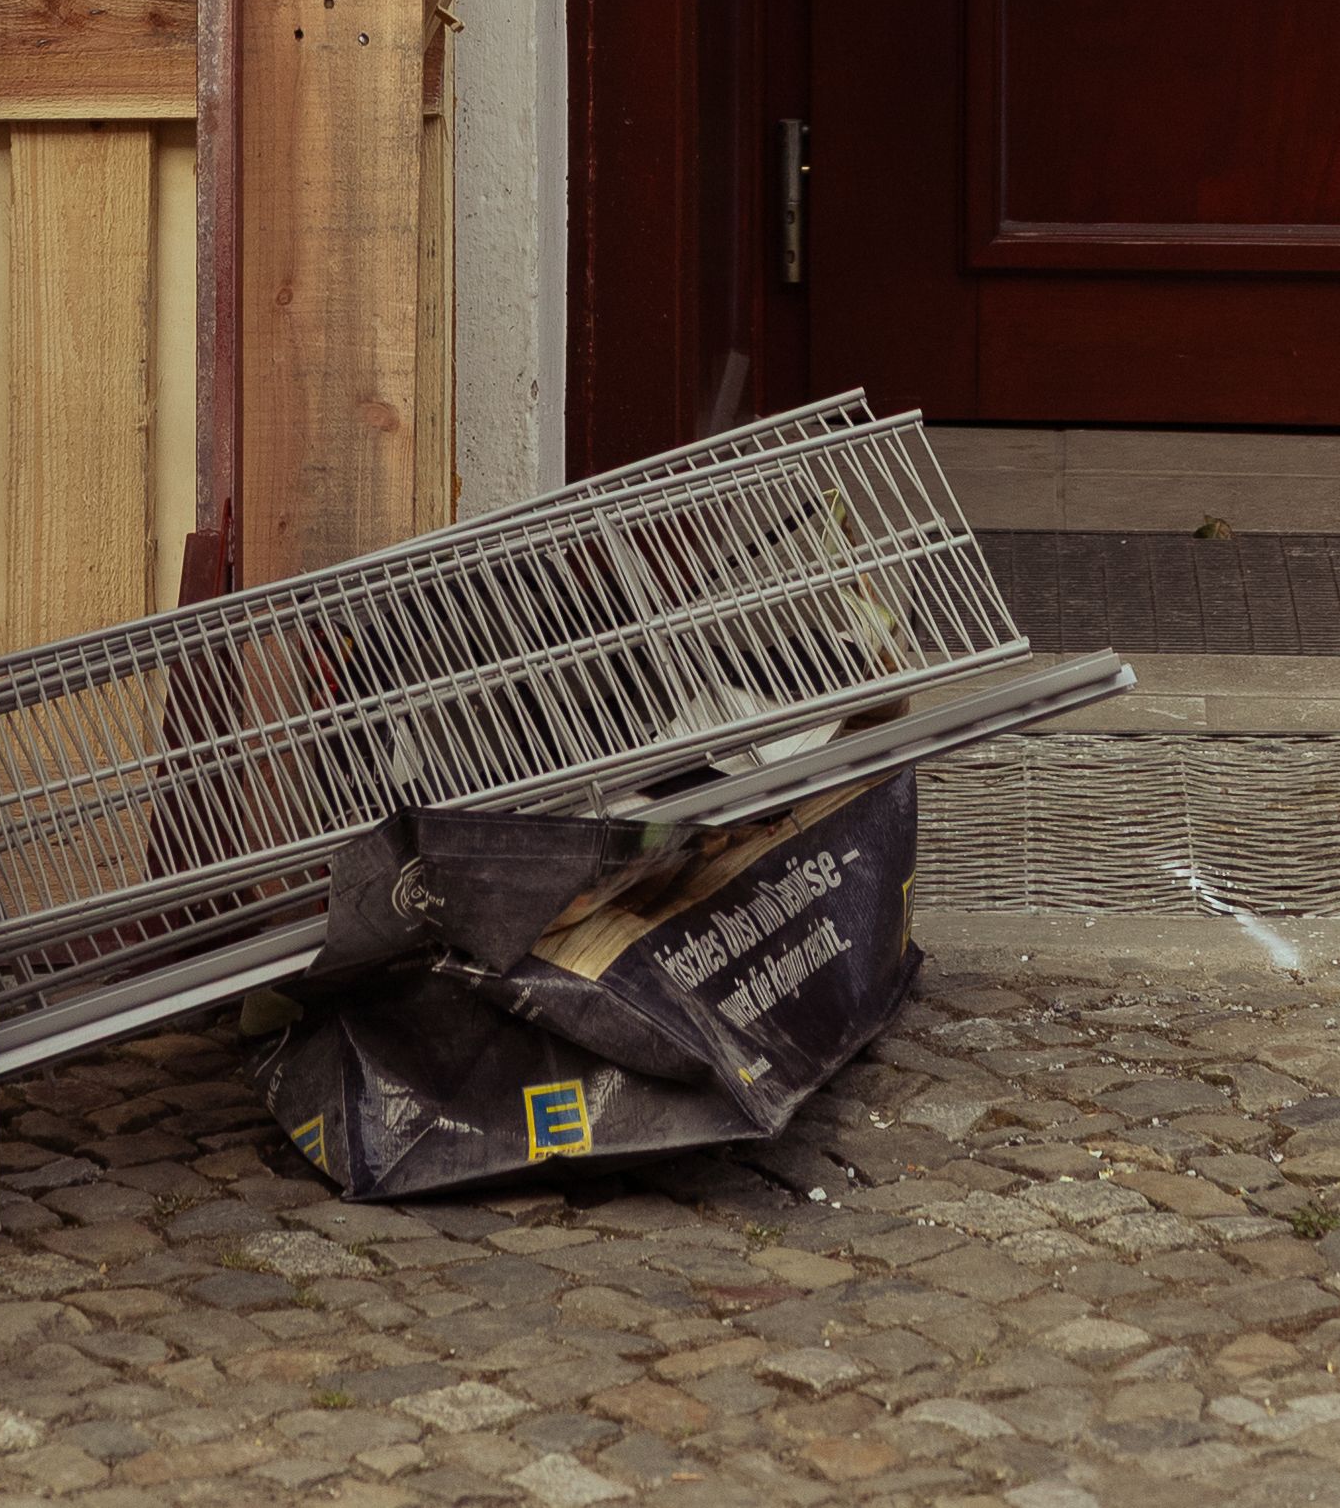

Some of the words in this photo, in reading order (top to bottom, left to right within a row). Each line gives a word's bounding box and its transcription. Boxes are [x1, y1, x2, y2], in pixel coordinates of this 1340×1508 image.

[757, 851, 842, 918] Gemüse
[710, 905, 763, 958] Obst
[747, 887, 786, 936] und
[749, 966, 777, 1011] die
[764, 943, 809, 998] Region
[534, 1145, 586, 1159] EDKA
